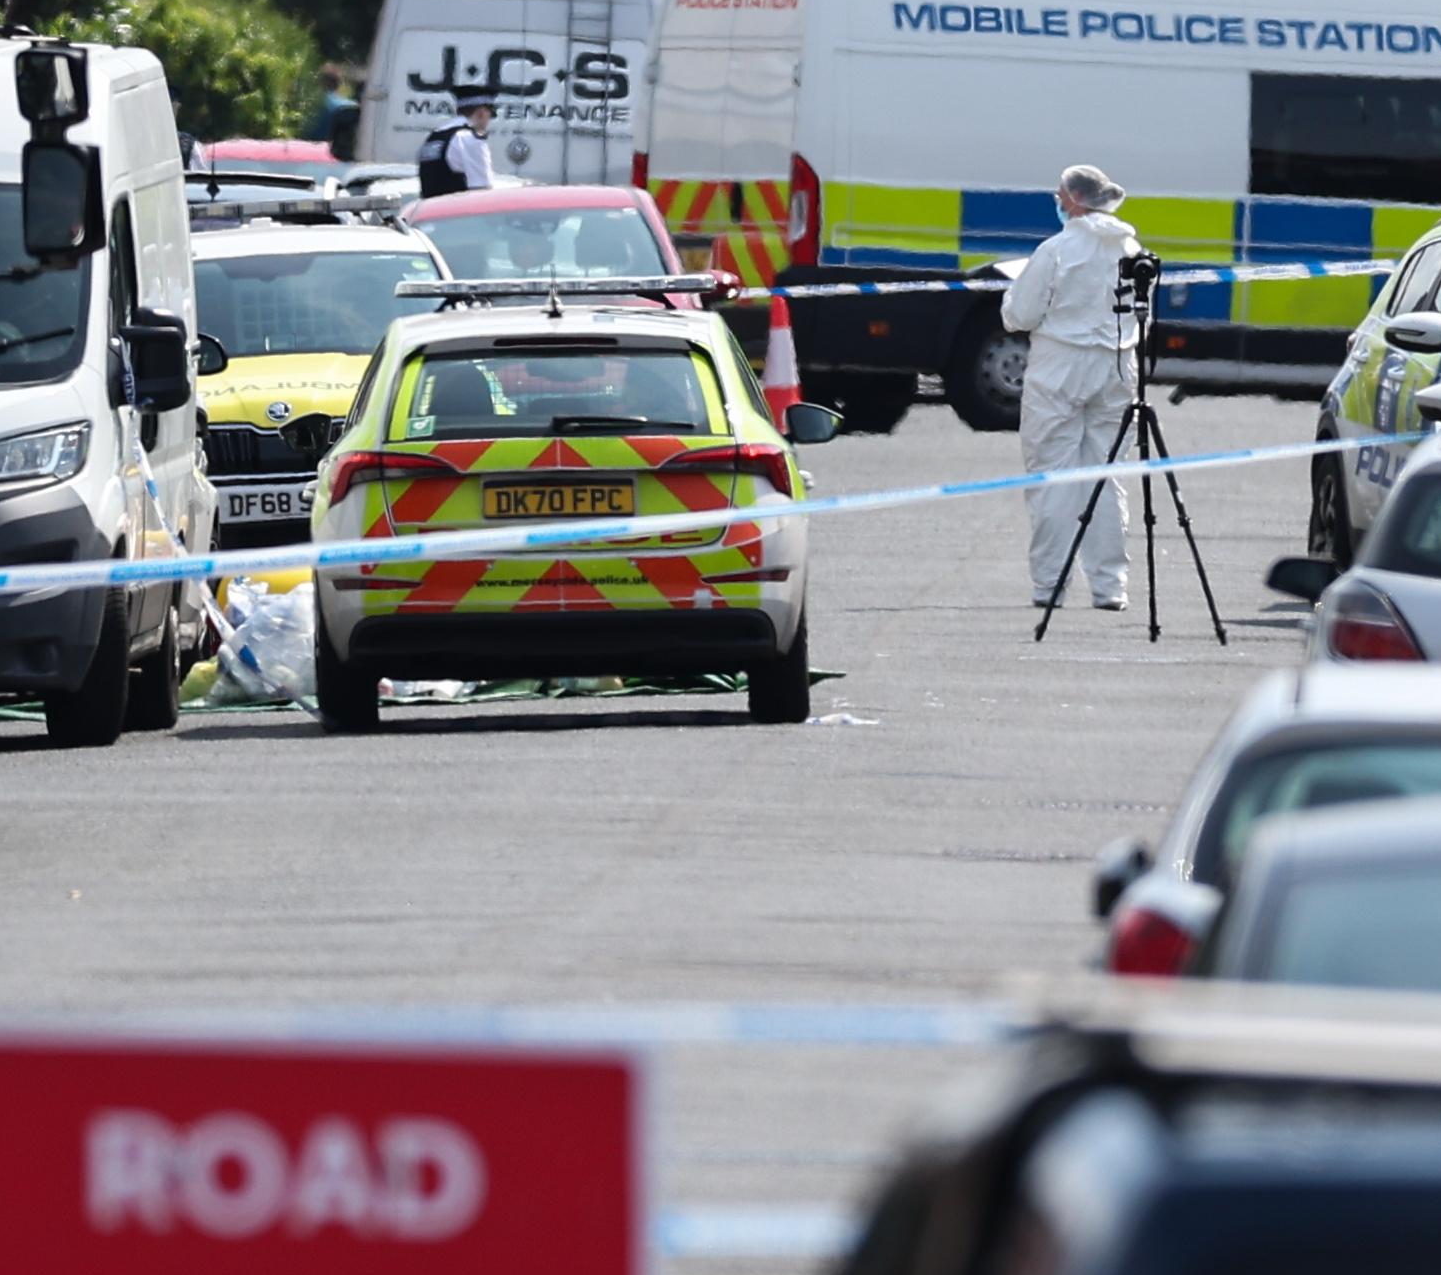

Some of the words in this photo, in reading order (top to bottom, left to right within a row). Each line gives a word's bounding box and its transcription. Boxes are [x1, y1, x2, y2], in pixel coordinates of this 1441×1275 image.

[893, 2, 1068, 37] MOBILE
[1079, 10, 1246, 46] POLICE
[404, 100, 630, 123] MAENANCE
[228, 491, 291, 518] DF68
[495, 489, 565, 514] DK70
[572, 487, 623, 512] FPC
[85, 1109, 485, 1239] ROAD
